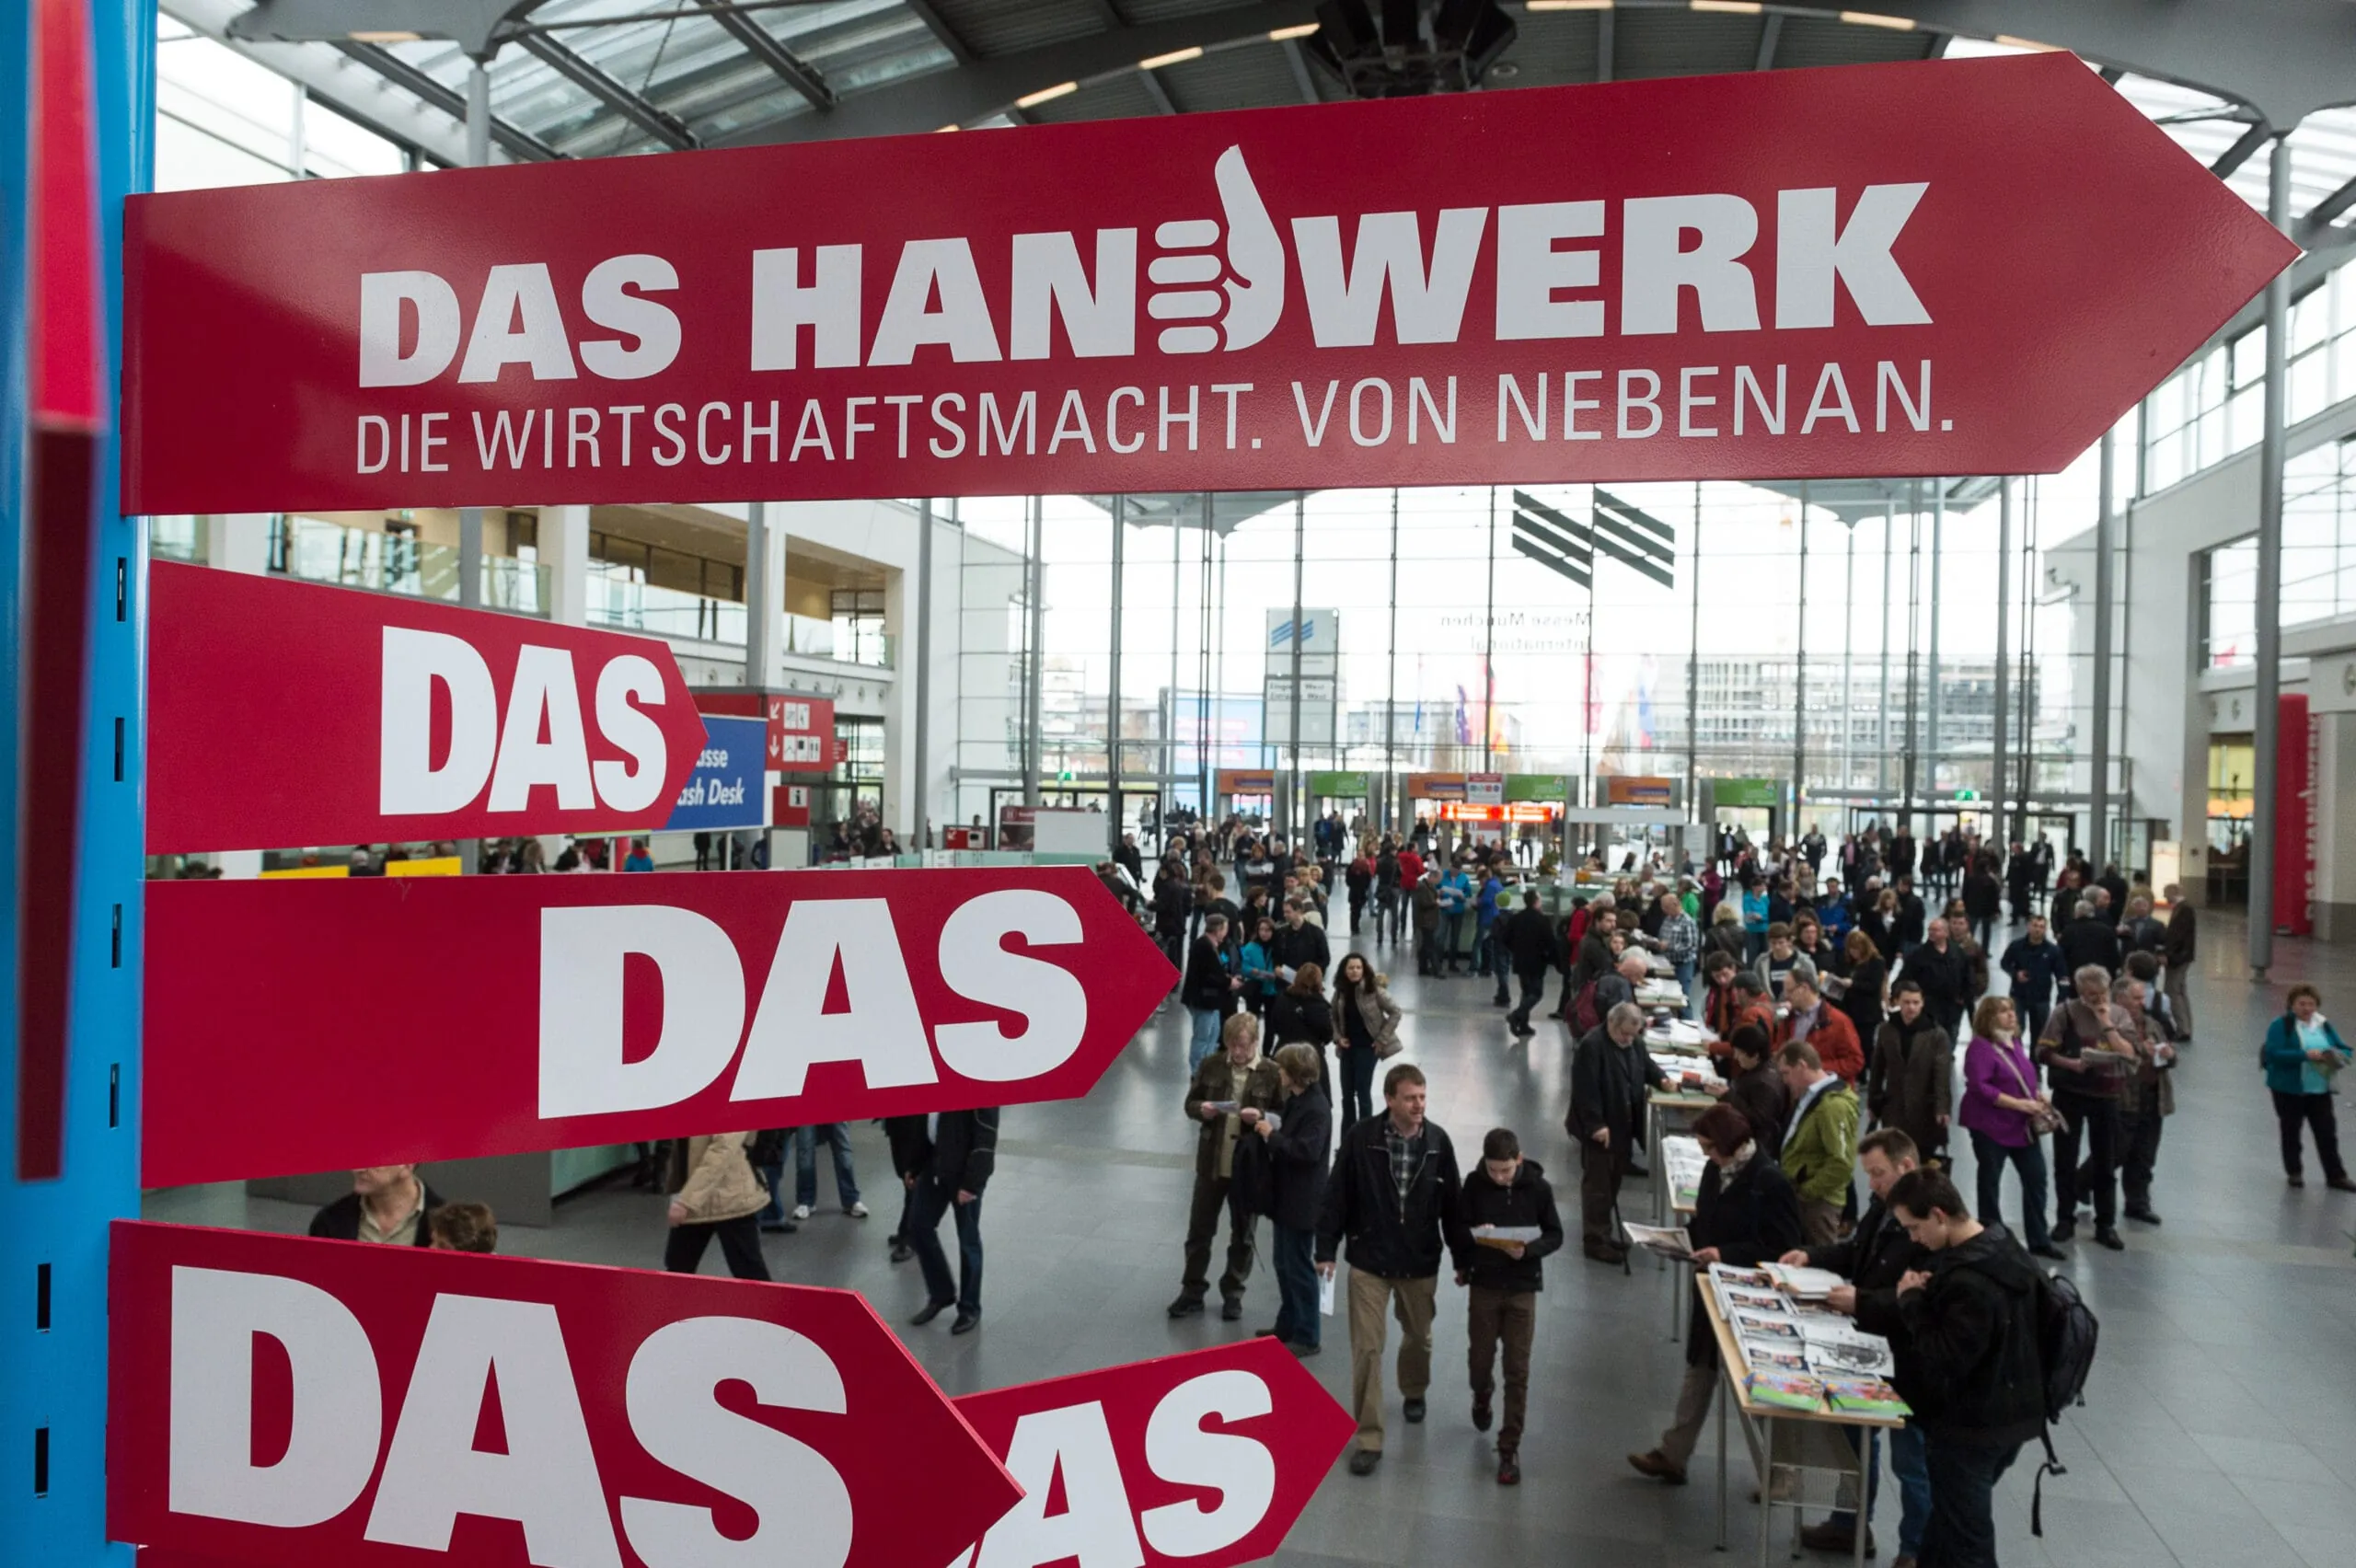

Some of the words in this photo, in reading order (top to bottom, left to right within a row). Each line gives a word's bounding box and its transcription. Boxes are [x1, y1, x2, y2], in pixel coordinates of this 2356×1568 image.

[360, 254, 681, 387] DAS
[751, 144, 1933, 371] HANDWERK
[358, 413, 448, 473] DIE
[472, 383, 1262, 469] WIRTSCHAFTSMACHT.
[1291, 375, 1457, 448] VON
[1497, 360, 1953, 444] NEBENAN.
[380, 626, 667, 816] DAS
[677, 777, 705, 806] ash
[707, 777, 745, 806] Desk
[696, 748, 729, 767] asse
[538, 890, 1088, 1120] DAS
[169, 1265, 853, 1568] DAS
[946, 1369, 1276, 1568] AS
